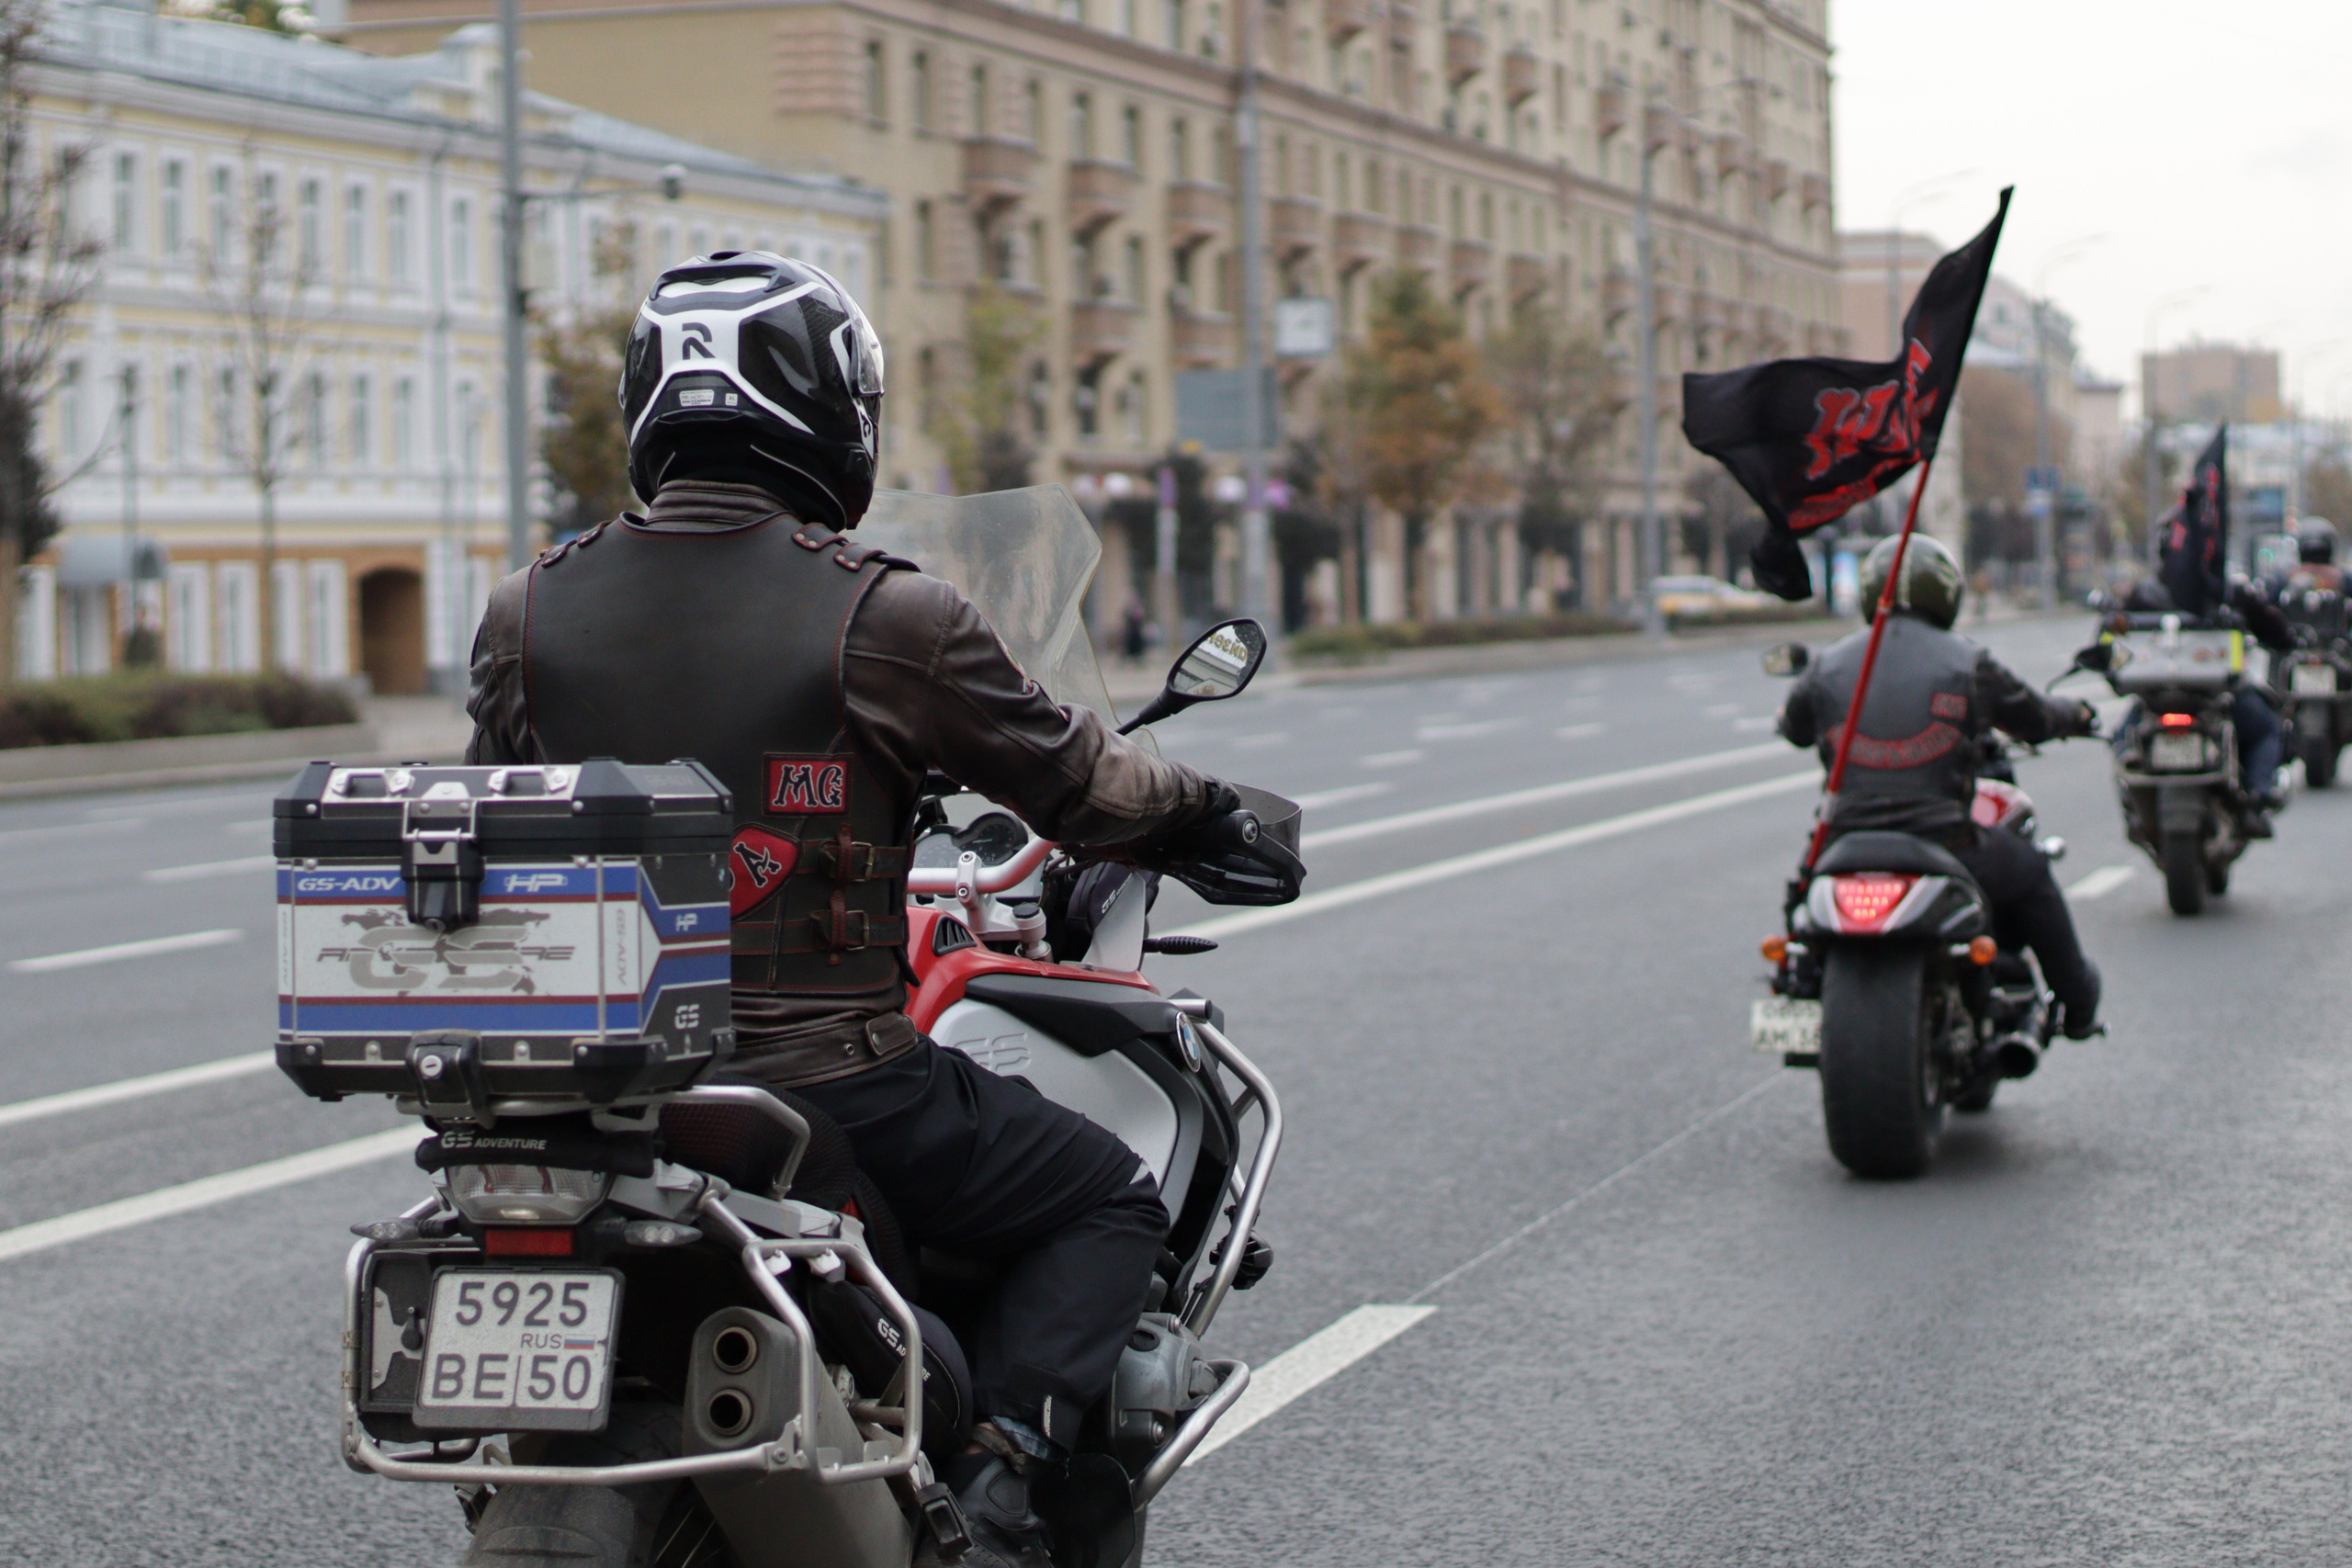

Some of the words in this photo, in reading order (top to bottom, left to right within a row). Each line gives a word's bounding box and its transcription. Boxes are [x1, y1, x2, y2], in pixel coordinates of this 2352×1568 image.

[297, 876, 401, 891] GS-ADV
[674, 1003, 700, 1029] GS
[474, 1136, 548, 1150] ADVENTURE
[455, 1281, 590, 1327] 5925
[520, 1333, 562, 1349] RUS
[877, 1317, 900, 1348] GS
[431, 1353, 509, 1399] BE
[527, 1354, 592, 1401] 50
